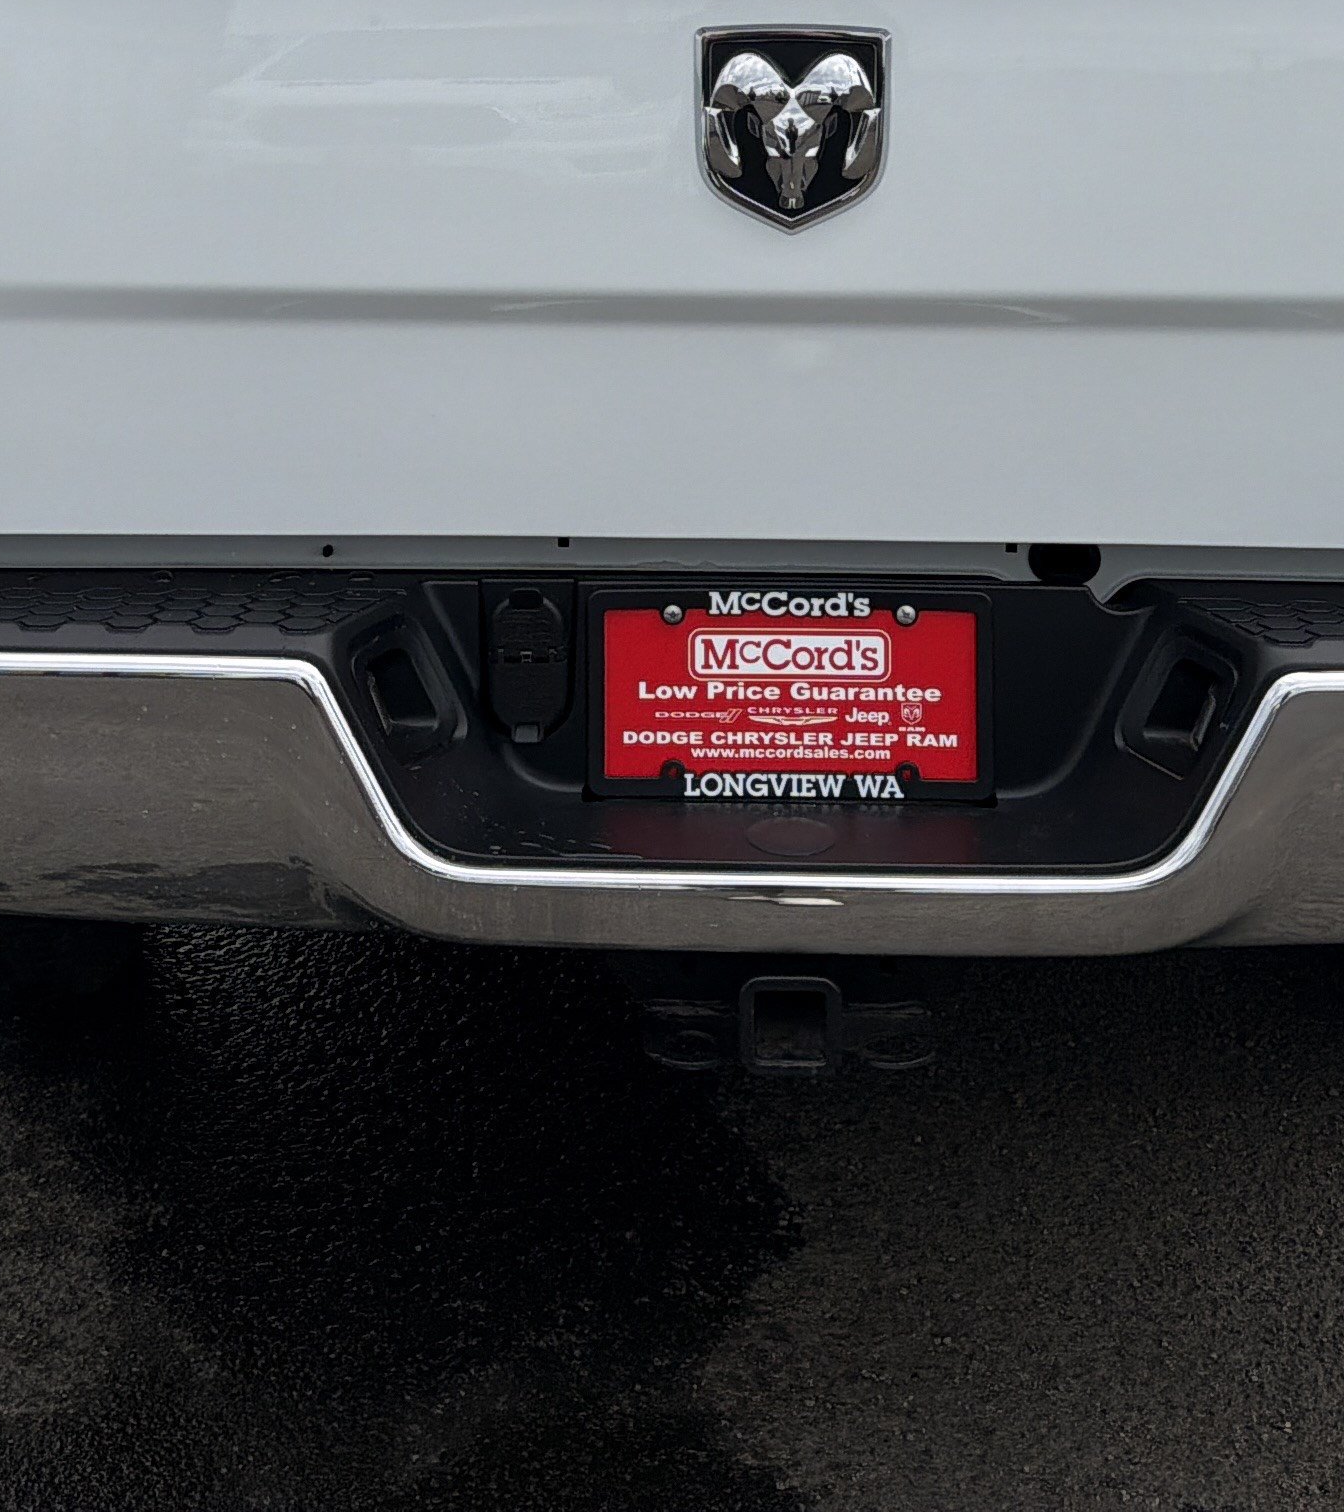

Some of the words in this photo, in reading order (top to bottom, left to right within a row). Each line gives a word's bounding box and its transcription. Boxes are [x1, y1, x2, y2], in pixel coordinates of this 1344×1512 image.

[708, 590, 872, 617] McCord's
[699, 637, 879, 672] McCord's
[638, 681, 698, 700] Low
[706, 681, 781, 701] Price
[790, 682, 942, 702] Guarantee
[654, 711, 728, 720] DODGE
[747, 706, 839, 716] CHRYSLER
[844, 707, 890, 726] Jeep
[622, 731, 704, 745] DODGE
[710, 731, 834, 747] CHRYSLER
[840, 732, 899, 747] JEEP
[906, 733, 958, 748] RAM
[690, 745, 892, 761] www.mccordsales.com
[683, 773, 845, 799] LONGVIEW
[854, 774, 905, 799] WA
